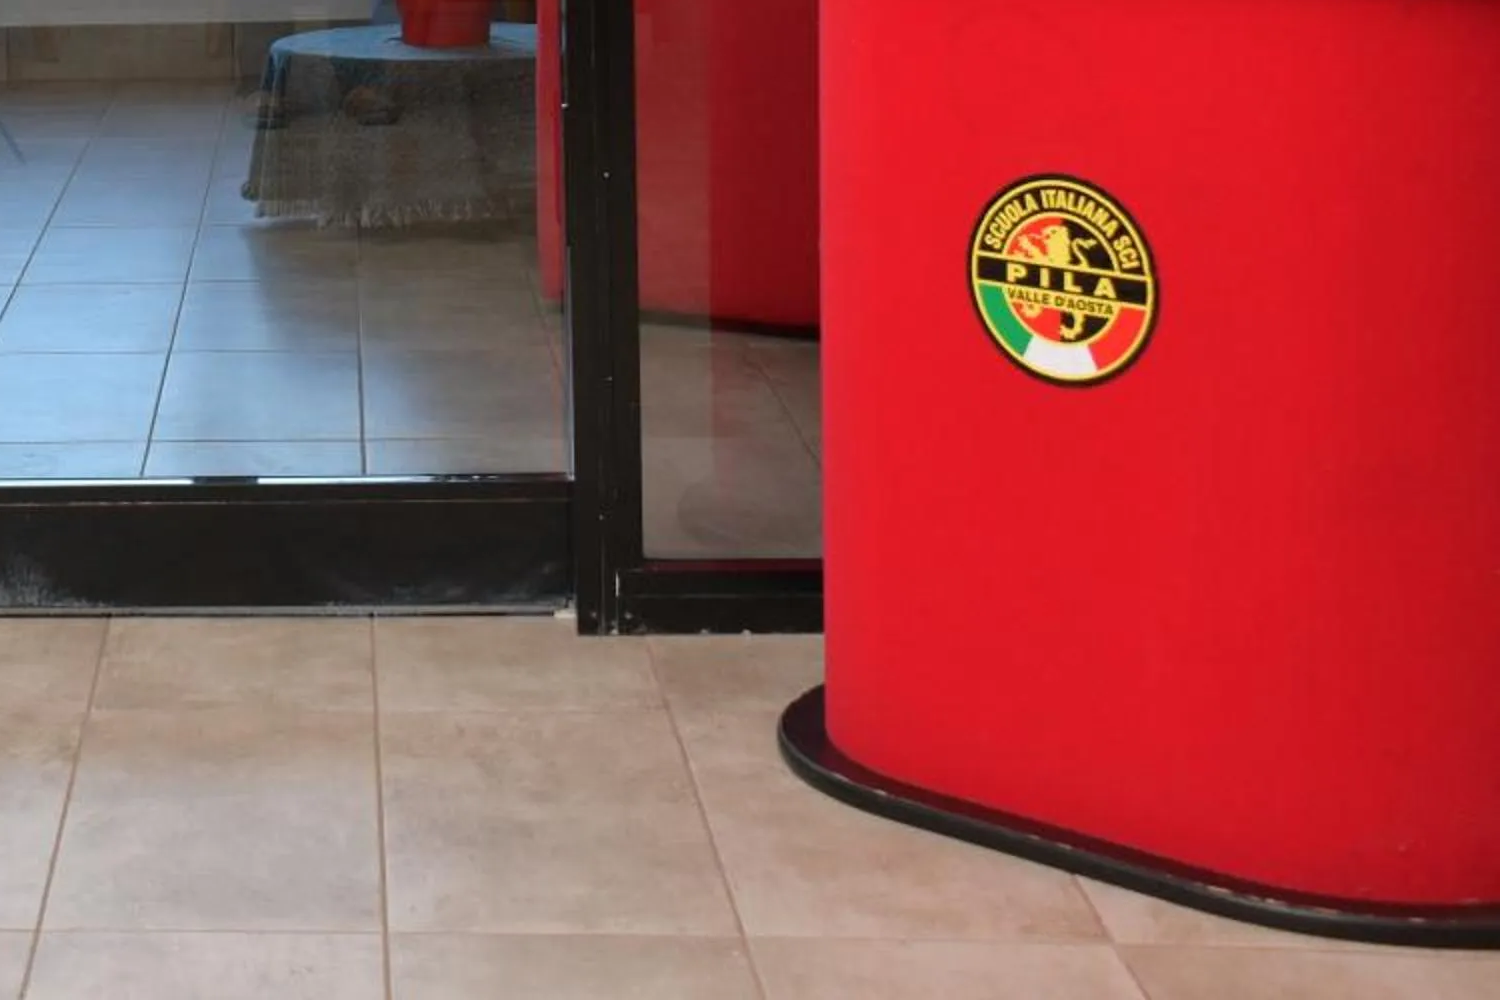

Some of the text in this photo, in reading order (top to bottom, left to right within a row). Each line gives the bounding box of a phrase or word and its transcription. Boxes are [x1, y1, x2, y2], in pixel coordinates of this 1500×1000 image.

[984, 189, 1140, 269] SCUOLA ITALIANA SCI
[1006, 262, 1116, 299] PILA
[1008, 287, 1113, 315] VALLE D'AOSTA
